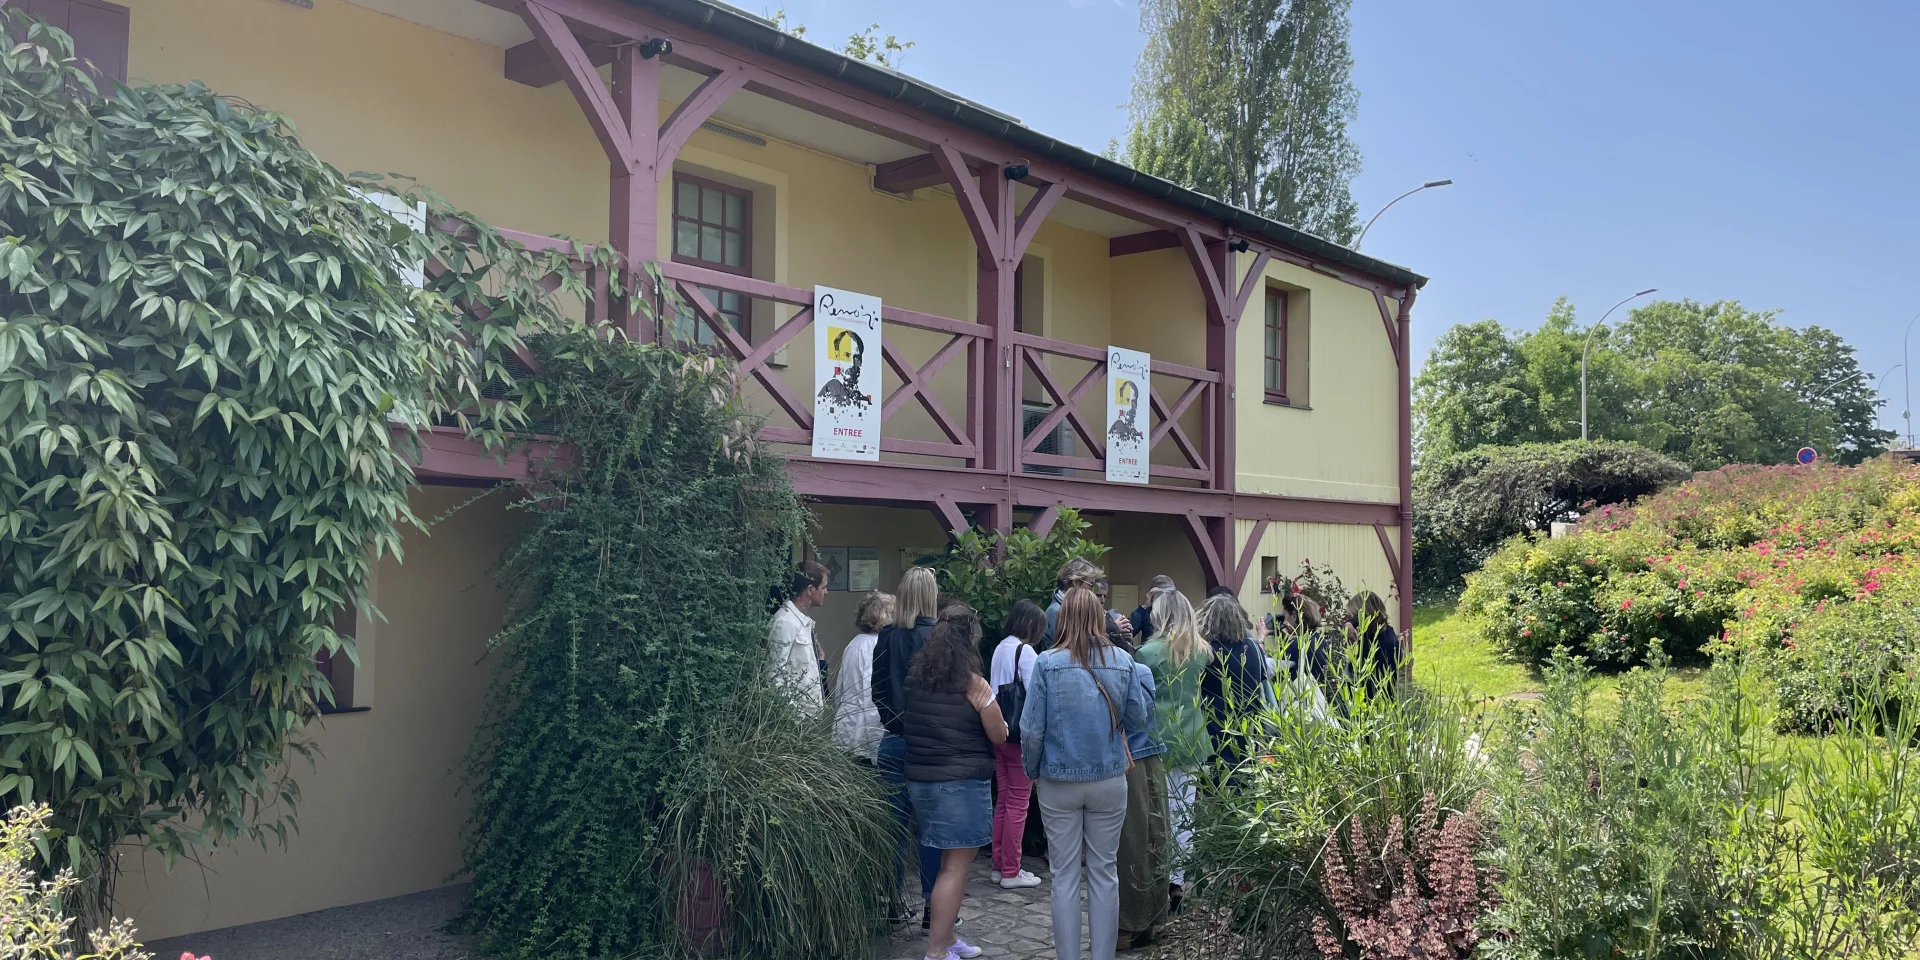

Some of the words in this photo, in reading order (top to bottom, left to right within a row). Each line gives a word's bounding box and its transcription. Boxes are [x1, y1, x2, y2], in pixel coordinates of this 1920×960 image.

[819, 294, 879, 330] Renoir
[1111, 352, 1149, 380] Renoir
[833, 427, 863, 437] ENTREE
[1118, 457, 1138, 466] ENTREE
